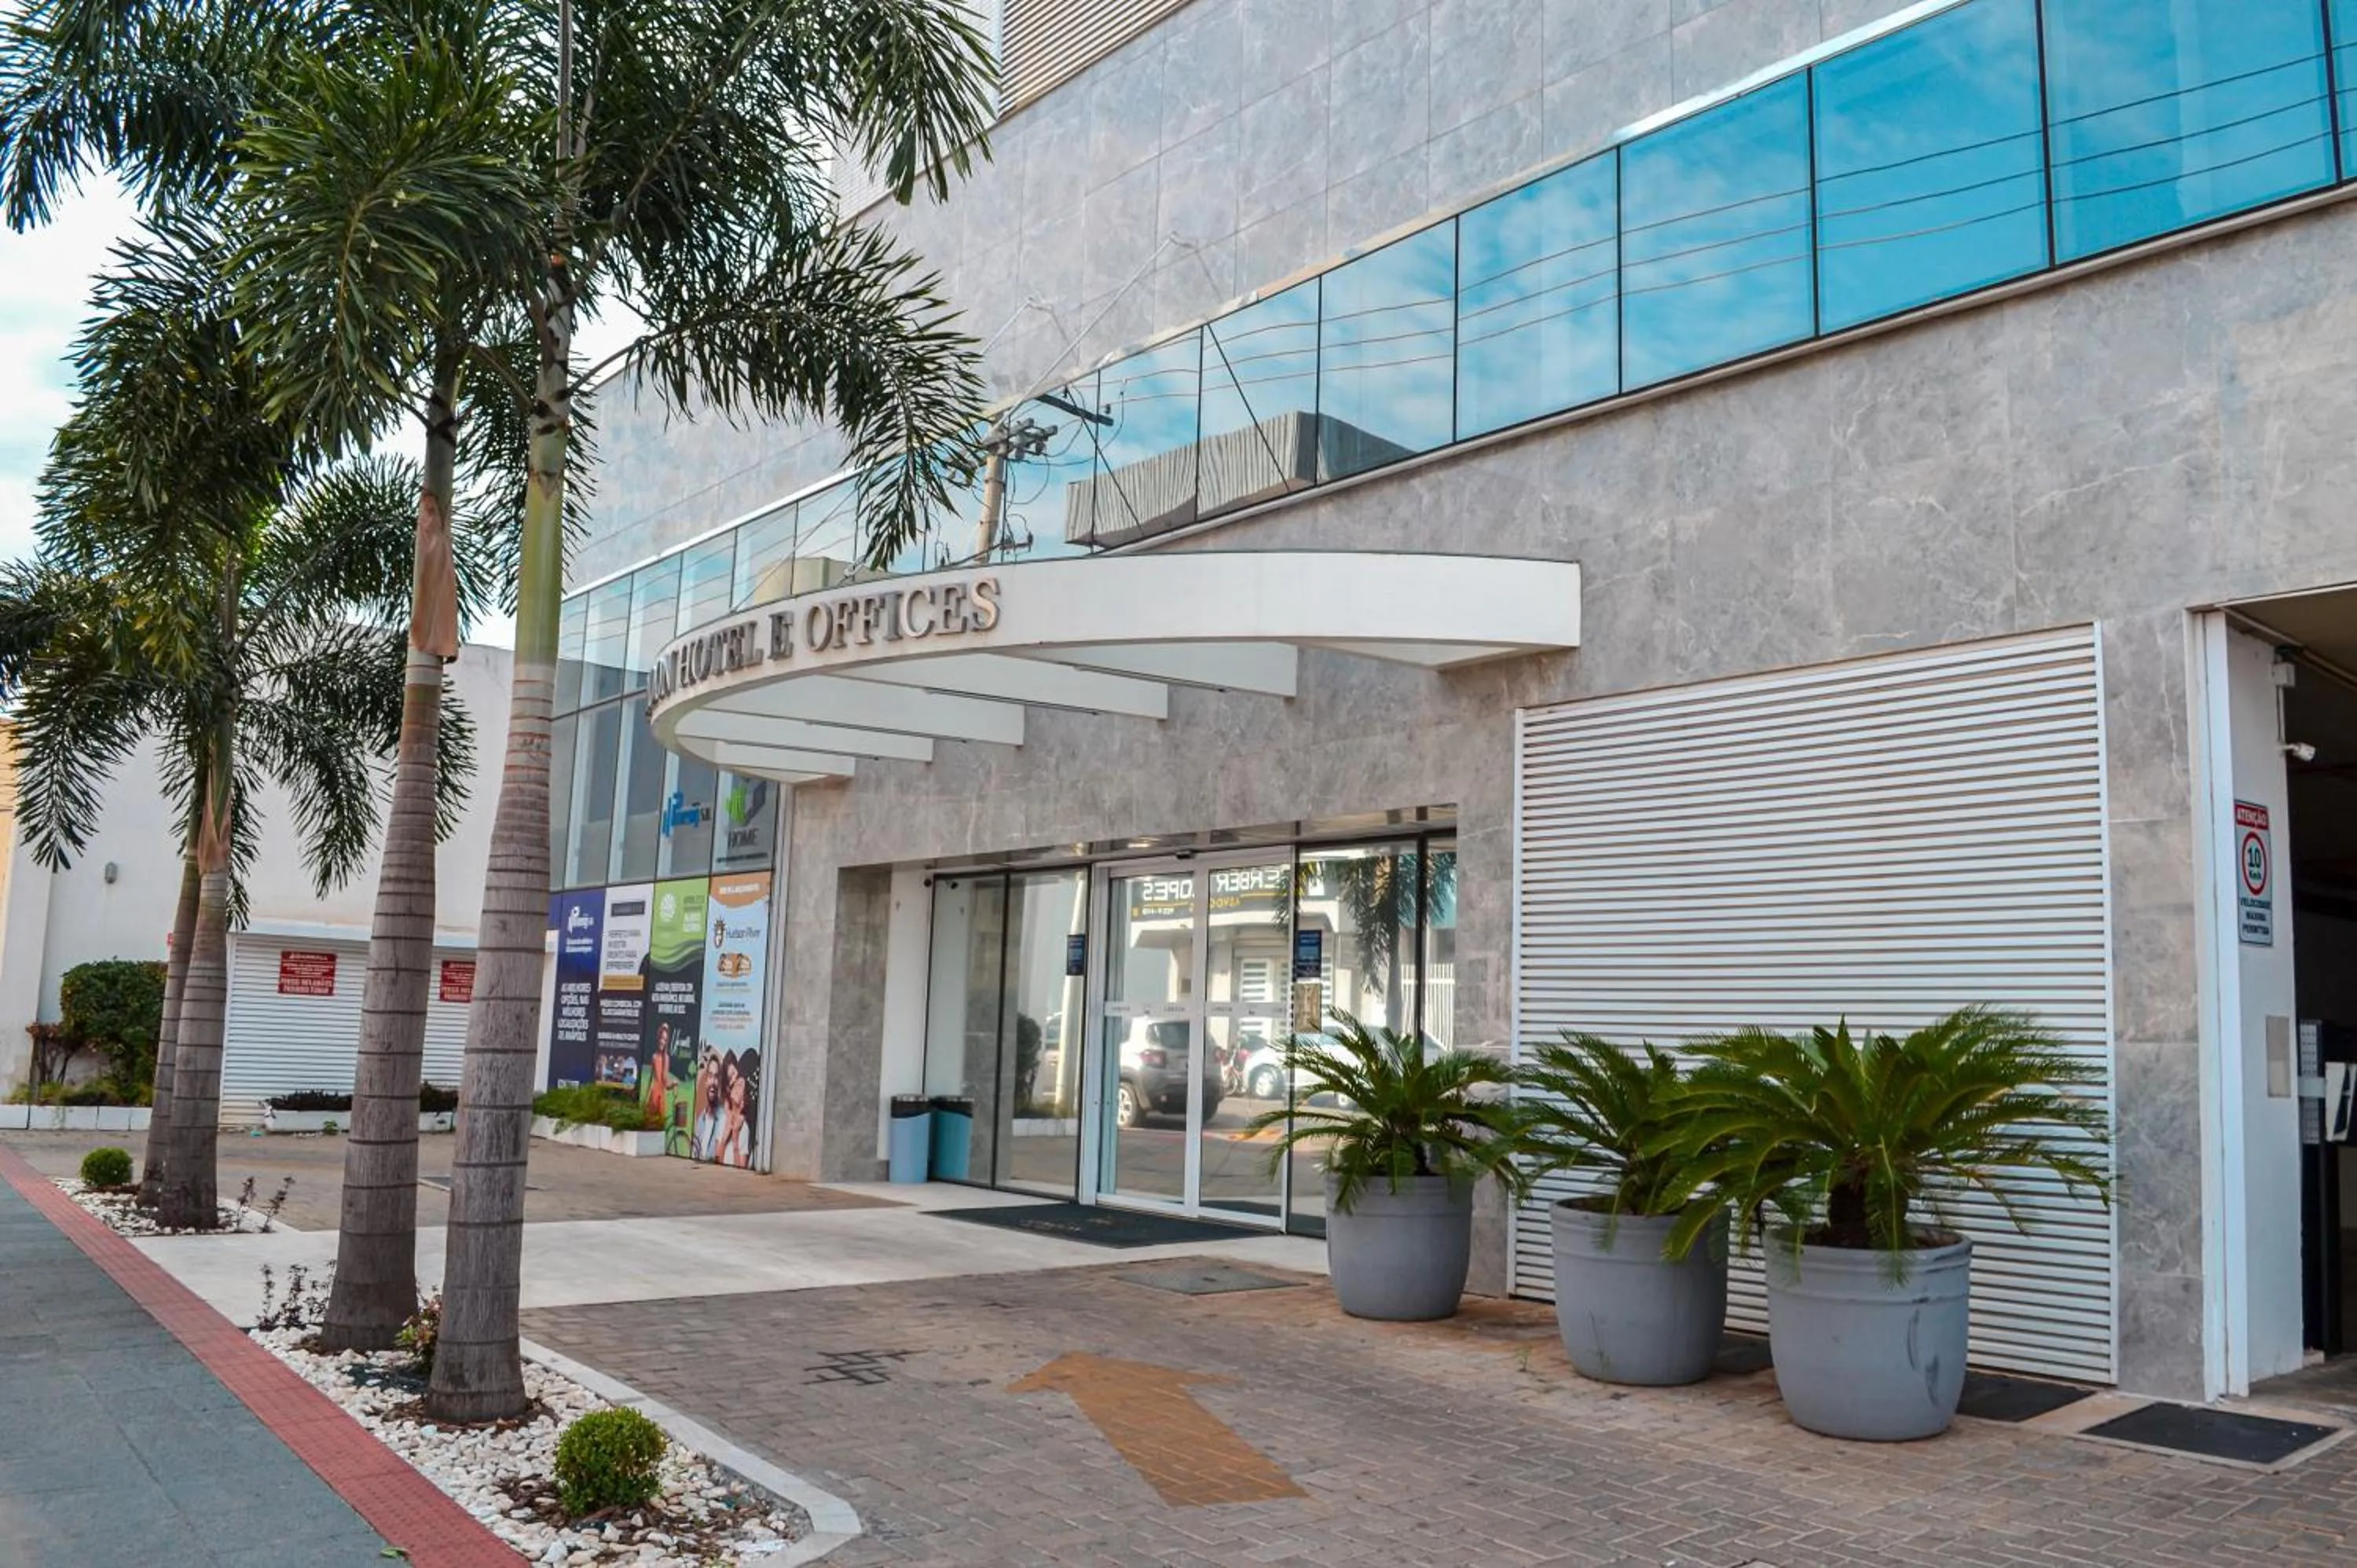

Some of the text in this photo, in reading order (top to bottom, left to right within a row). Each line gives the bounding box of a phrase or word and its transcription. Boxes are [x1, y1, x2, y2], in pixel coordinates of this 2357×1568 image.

[679, 621, 764, 690] HOTEL
[768, 610, 795, 661] E
[806, 577, 1001, 653] OFFICES
[2248, 847, 2262, 868] 10
